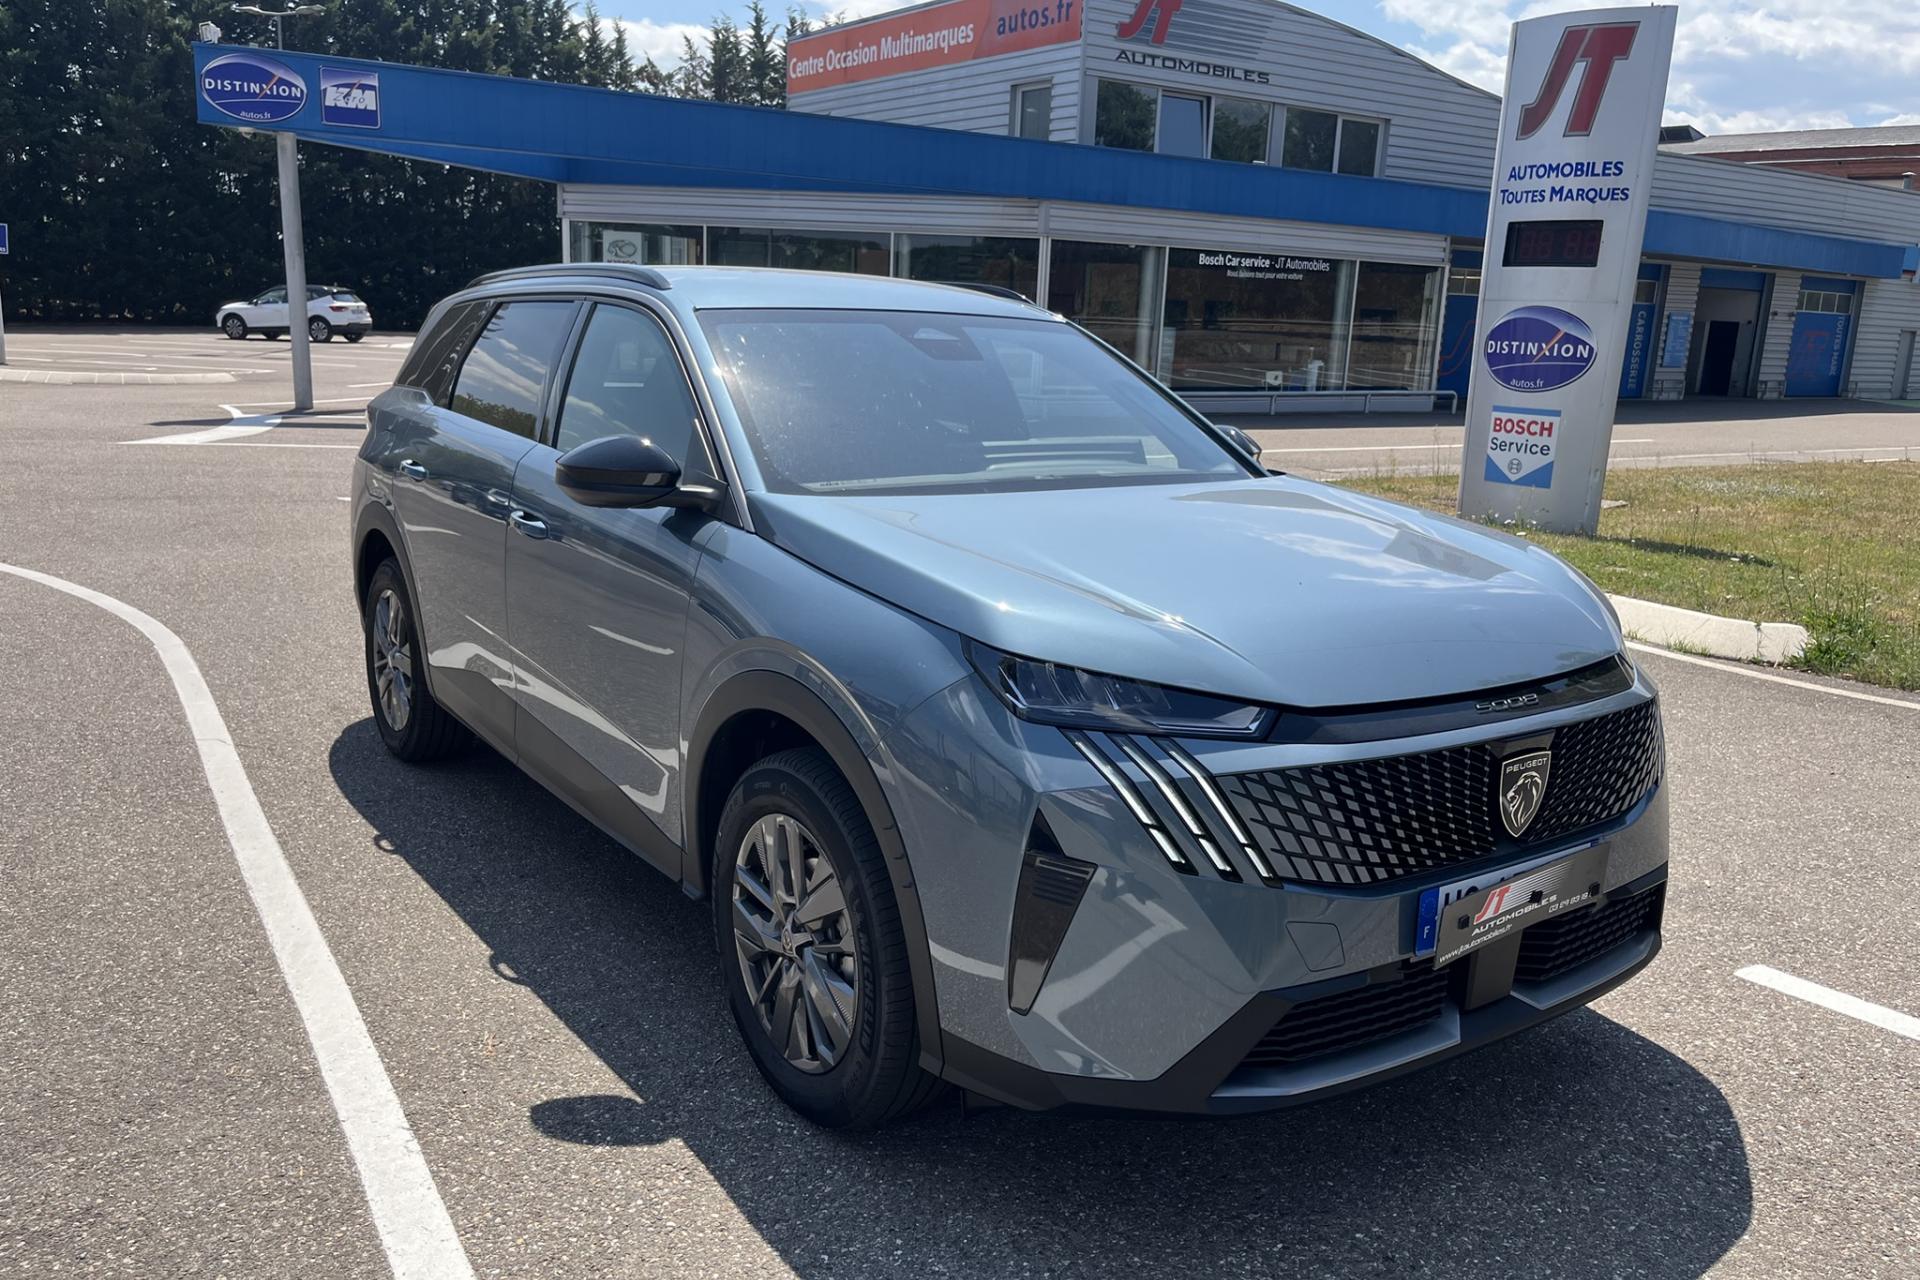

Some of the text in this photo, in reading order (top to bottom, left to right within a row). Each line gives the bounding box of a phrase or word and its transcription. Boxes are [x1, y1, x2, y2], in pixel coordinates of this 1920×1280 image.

[997, 0, 1073, 36] autos.fr
[790, 23, 974, 80] Centre Occasion Multimarques
[1115, 50, 1270, 84] AUTOMOBILES
[204, 78, 301, 98] DISTINXION
[1516, 21, 1641, 140] JT
[240, 110, 271, 120] autos.fr
[1508, 161, 1624, 182] AUTOMOBILES
[1199, 253, 1224, 266] Bosch
[1225, 254, 1240, 267] Car
[1240, 256, 1270, 268] service
[1275, 257, 1284, 269] JT
[1286, 258, 1330, 272] Automobiles
[1487, 340, 1590, 359] DISTINXION
[1627, 310, 1647, 390] CARROSSERIE
[1510, 378, 1544, 389] autos.fr
[1493, 417, 1553, 438] BOSCH
[1490, 437, 1550, 456] Service
[1475, 693, 1539, 714] 5008
[1505, 757, 1548, 774] PEUGEOT
[1471, 894, 1558, 937] AUTOMOBILES
[1473, 885, 1512, 925] JT
[1423, 926, 1430, 939] F
